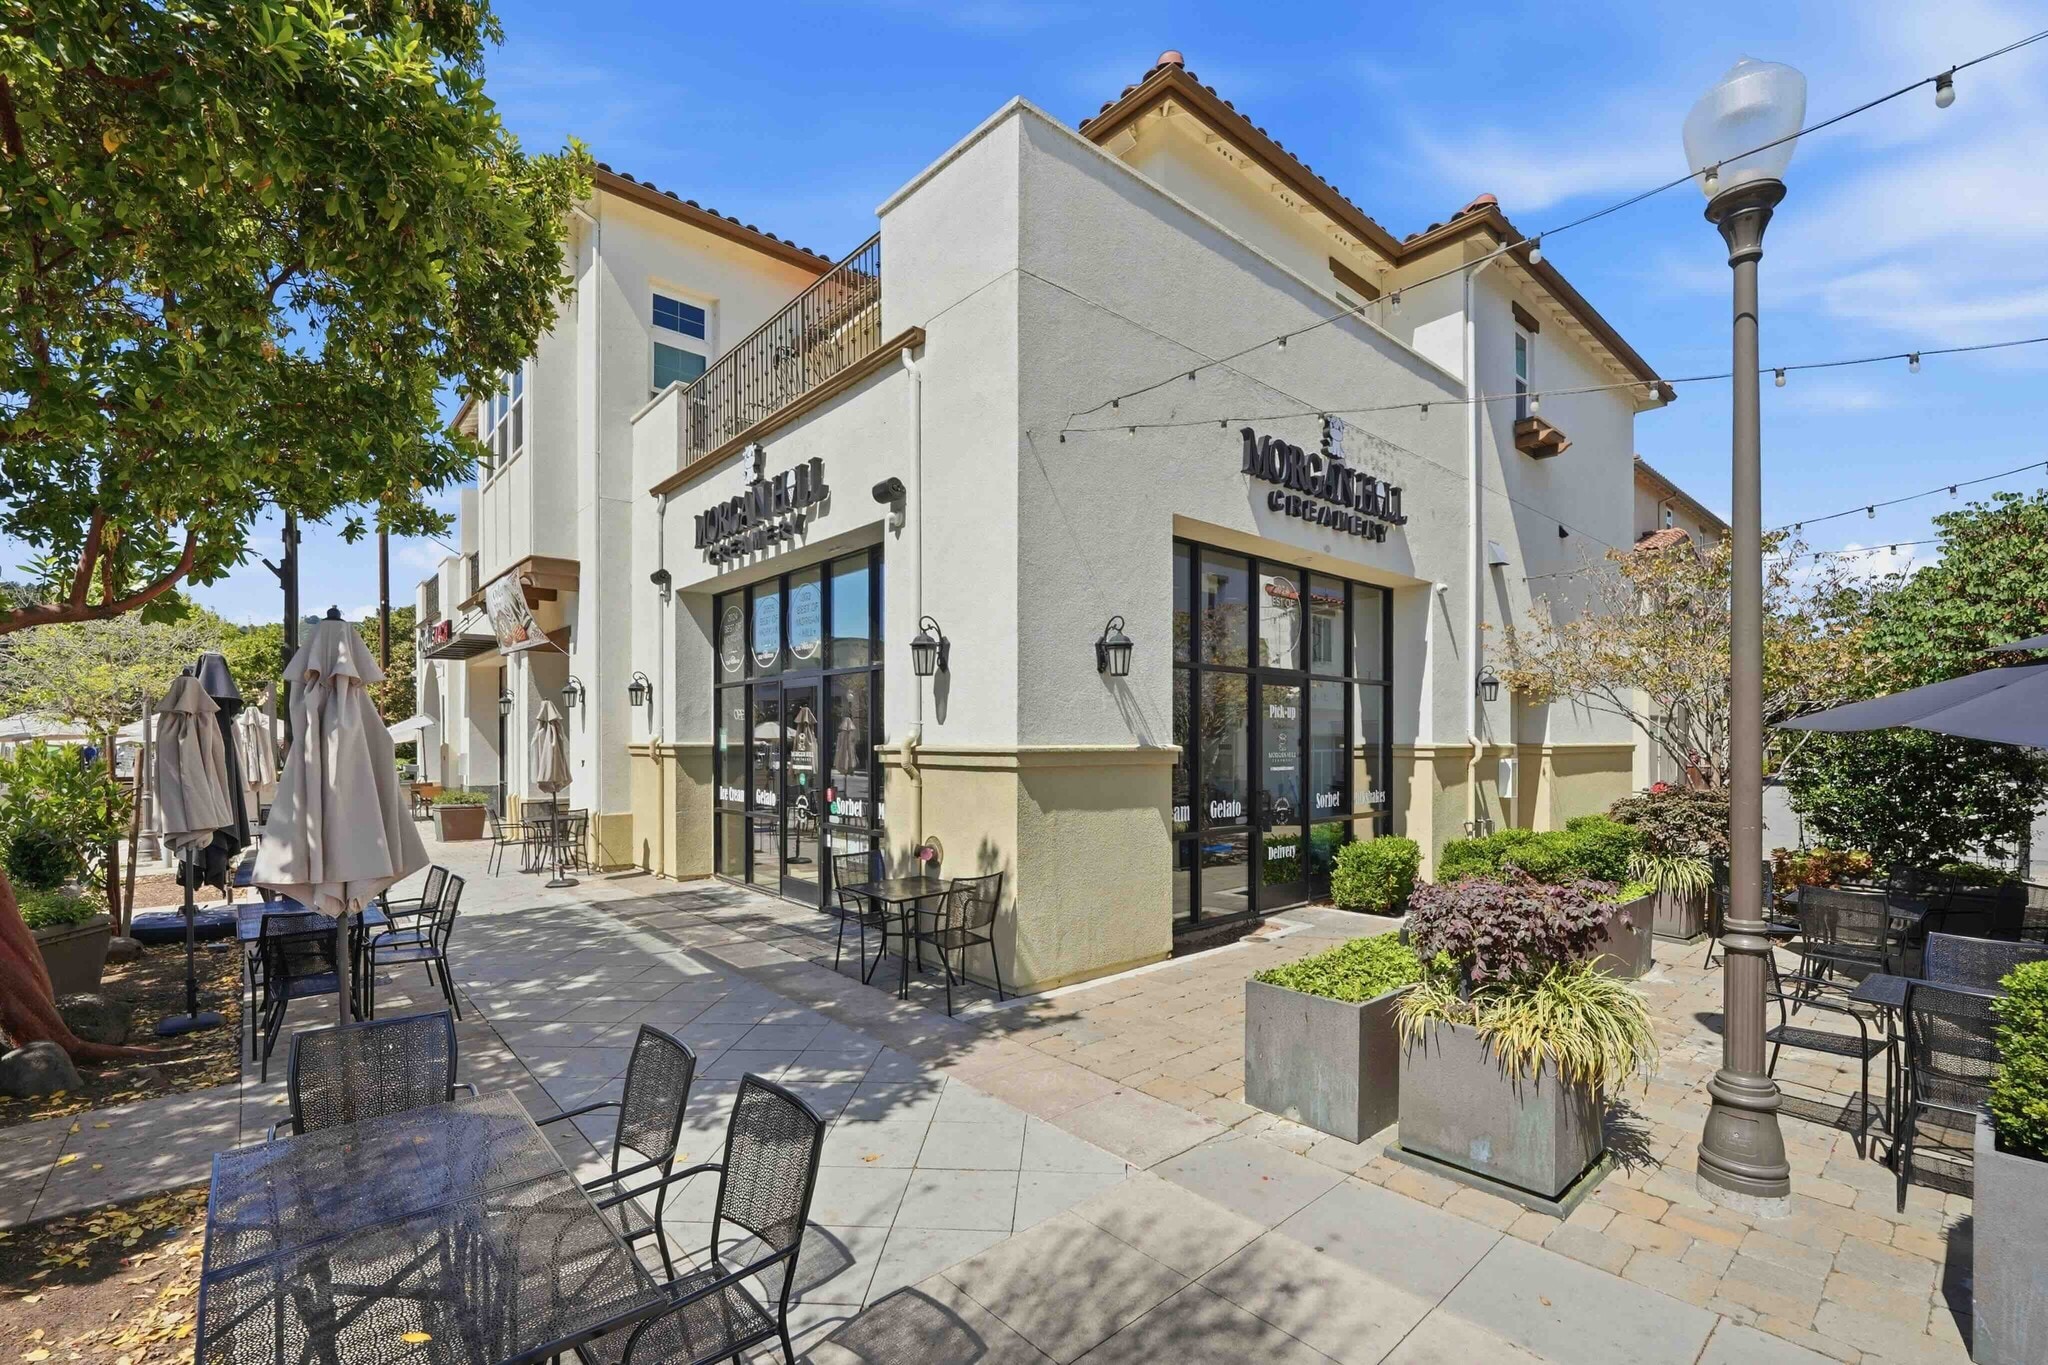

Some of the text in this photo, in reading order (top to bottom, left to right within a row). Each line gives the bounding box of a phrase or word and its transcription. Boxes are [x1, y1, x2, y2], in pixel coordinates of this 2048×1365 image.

[1240, 427, 1357, 508] MORGAN
[694, 480, 774, 549] MORGAN
[1268, 489, 1389, 543] CREAMERY
[720, 786, 745, 802] Ice Cream
[756, 788, 776, 807] Gelato
[1316, 790, 1340, 809] Sorbet
[836, 797, 862, 817] Sorbet
[1210, 800, 1241, 819] Gelato
[1268, 844, 1296, 861] Delivery
